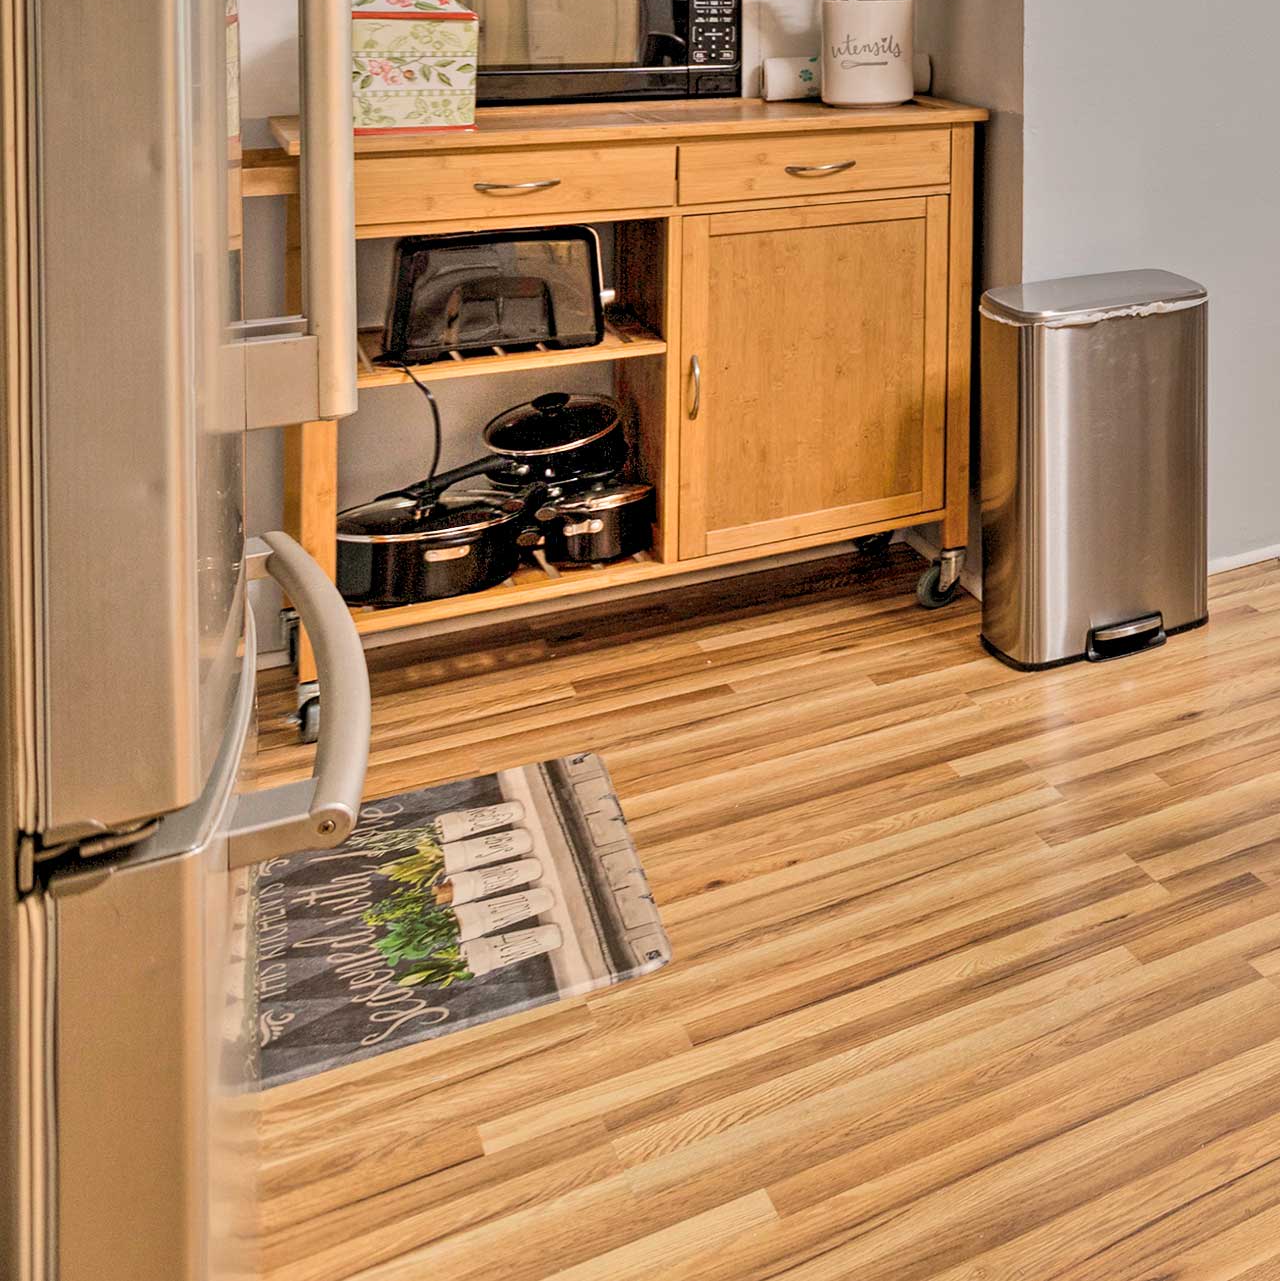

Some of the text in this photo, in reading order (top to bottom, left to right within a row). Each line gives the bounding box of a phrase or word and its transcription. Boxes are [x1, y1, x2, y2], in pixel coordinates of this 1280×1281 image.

[831, 33, 903, 59] utensils
[290, 865, 379, 926] with
[292, 925, 450, 1046] Seasoned
